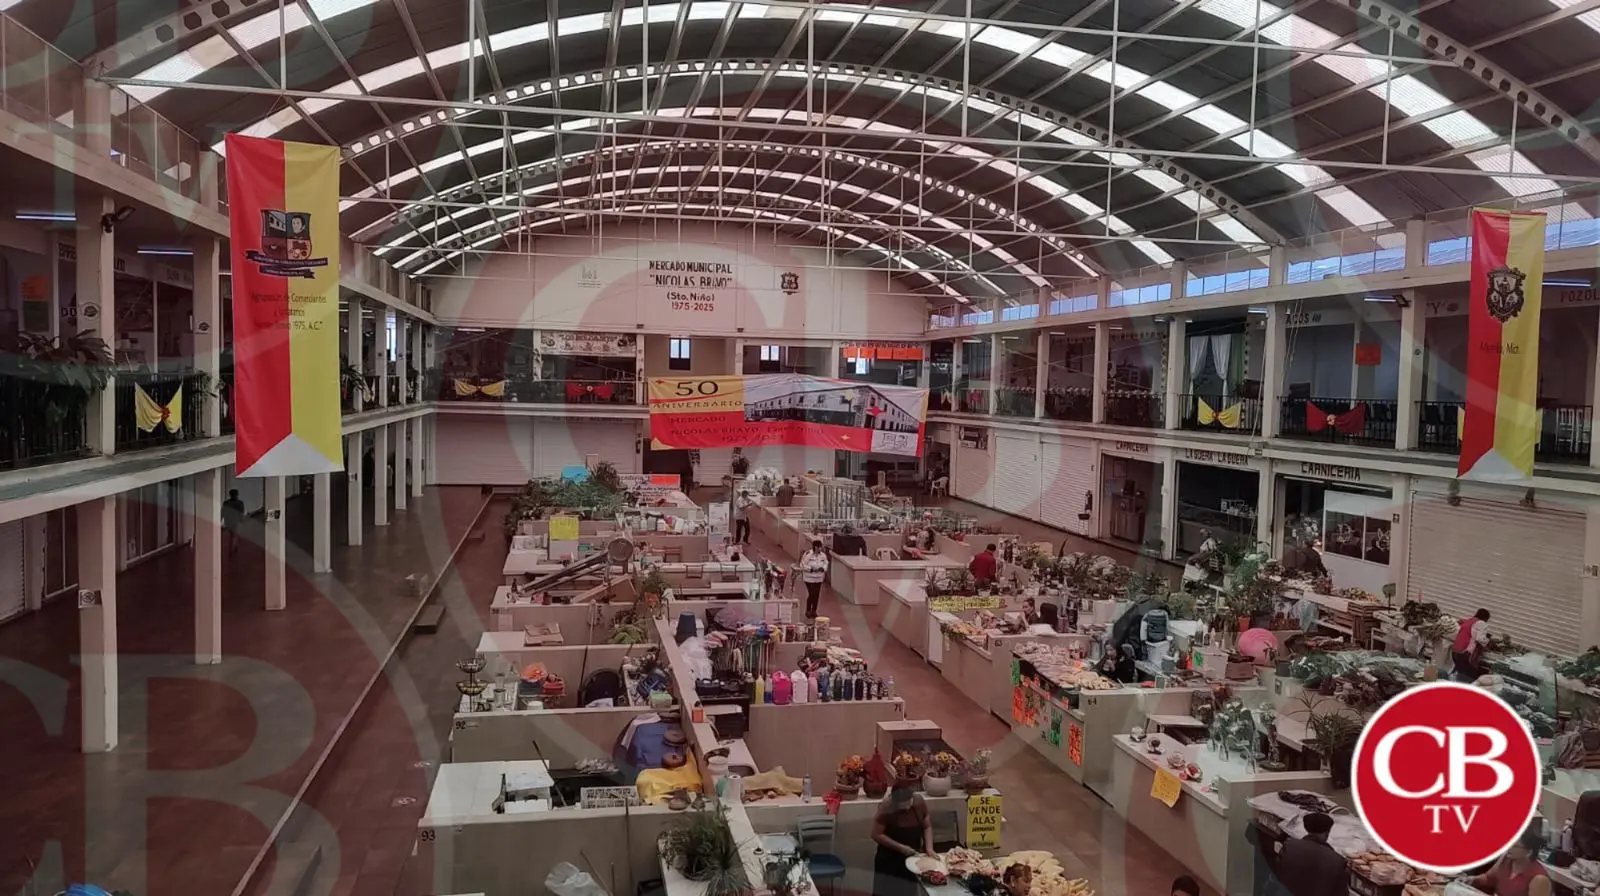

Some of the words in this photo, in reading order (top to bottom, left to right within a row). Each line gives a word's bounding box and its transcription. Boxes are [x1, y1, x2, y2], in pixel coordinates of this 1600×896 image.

[649, 260, 686, 271] MERCADO
[686, 262, 733, 274] MUNICIPAL
[667, 291, 689, 301] (Sto.
[690, 292, 715, 302] Niño)
[671, 301, 714, 312] 1975-2025
[675, 380, 719, 396] 50
[653, 400, 742, 409] ANIVERSARIO
[1301, 461, 1361, 481] CARNICERIA
[980, 796, 991, 805] SE
[968, 805, 1001, 815] VENDE
[972, 816, 996, 825] ALAS
[421, 830, 436, 841] 93
[980, 833, 986, 841] Y
